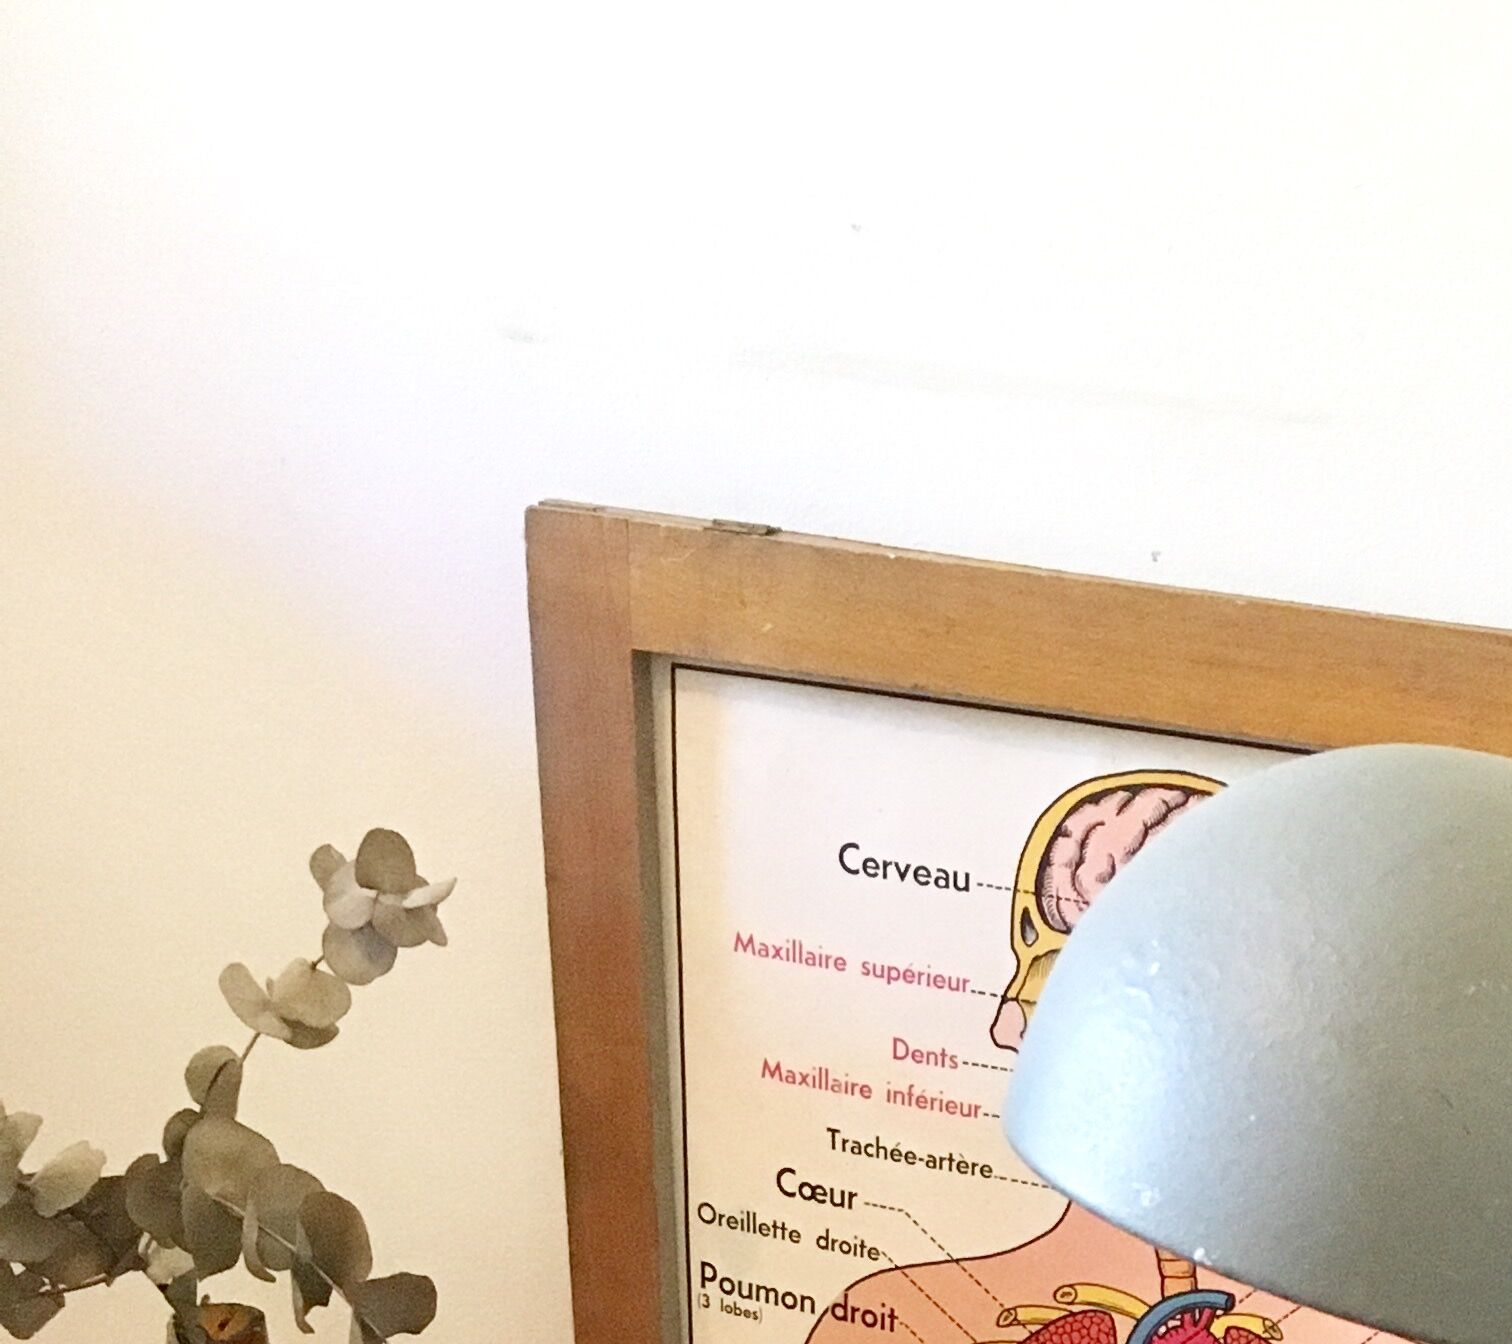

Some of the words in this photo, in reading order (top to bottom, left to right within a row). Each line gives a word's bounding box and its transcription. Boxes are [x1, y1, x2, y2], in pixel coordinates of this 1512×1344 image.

[838, 842, 971, 893] Cerveau
[733, 931, 847, 973] Maxillaire
[860, 958, 970, 995] supérieur
[892, 1037, 959, 1070] Dents
[761, 1058, 873, 1100] Maxillaire
[886, 1081, 982, 1120] inférieur
[826, 1127, 994, 1179] Trachée-artère
[776, 1167, 858, 1211] Cœur
[698, 1203, 801, 1245] Oreillette
[816, 1230, 882, 1263] droite
[700, 1261, 816, 1316] Poumon
[831, 1293, 899, 1334] droit
[720, 1296, 764, 1324] lobes)
